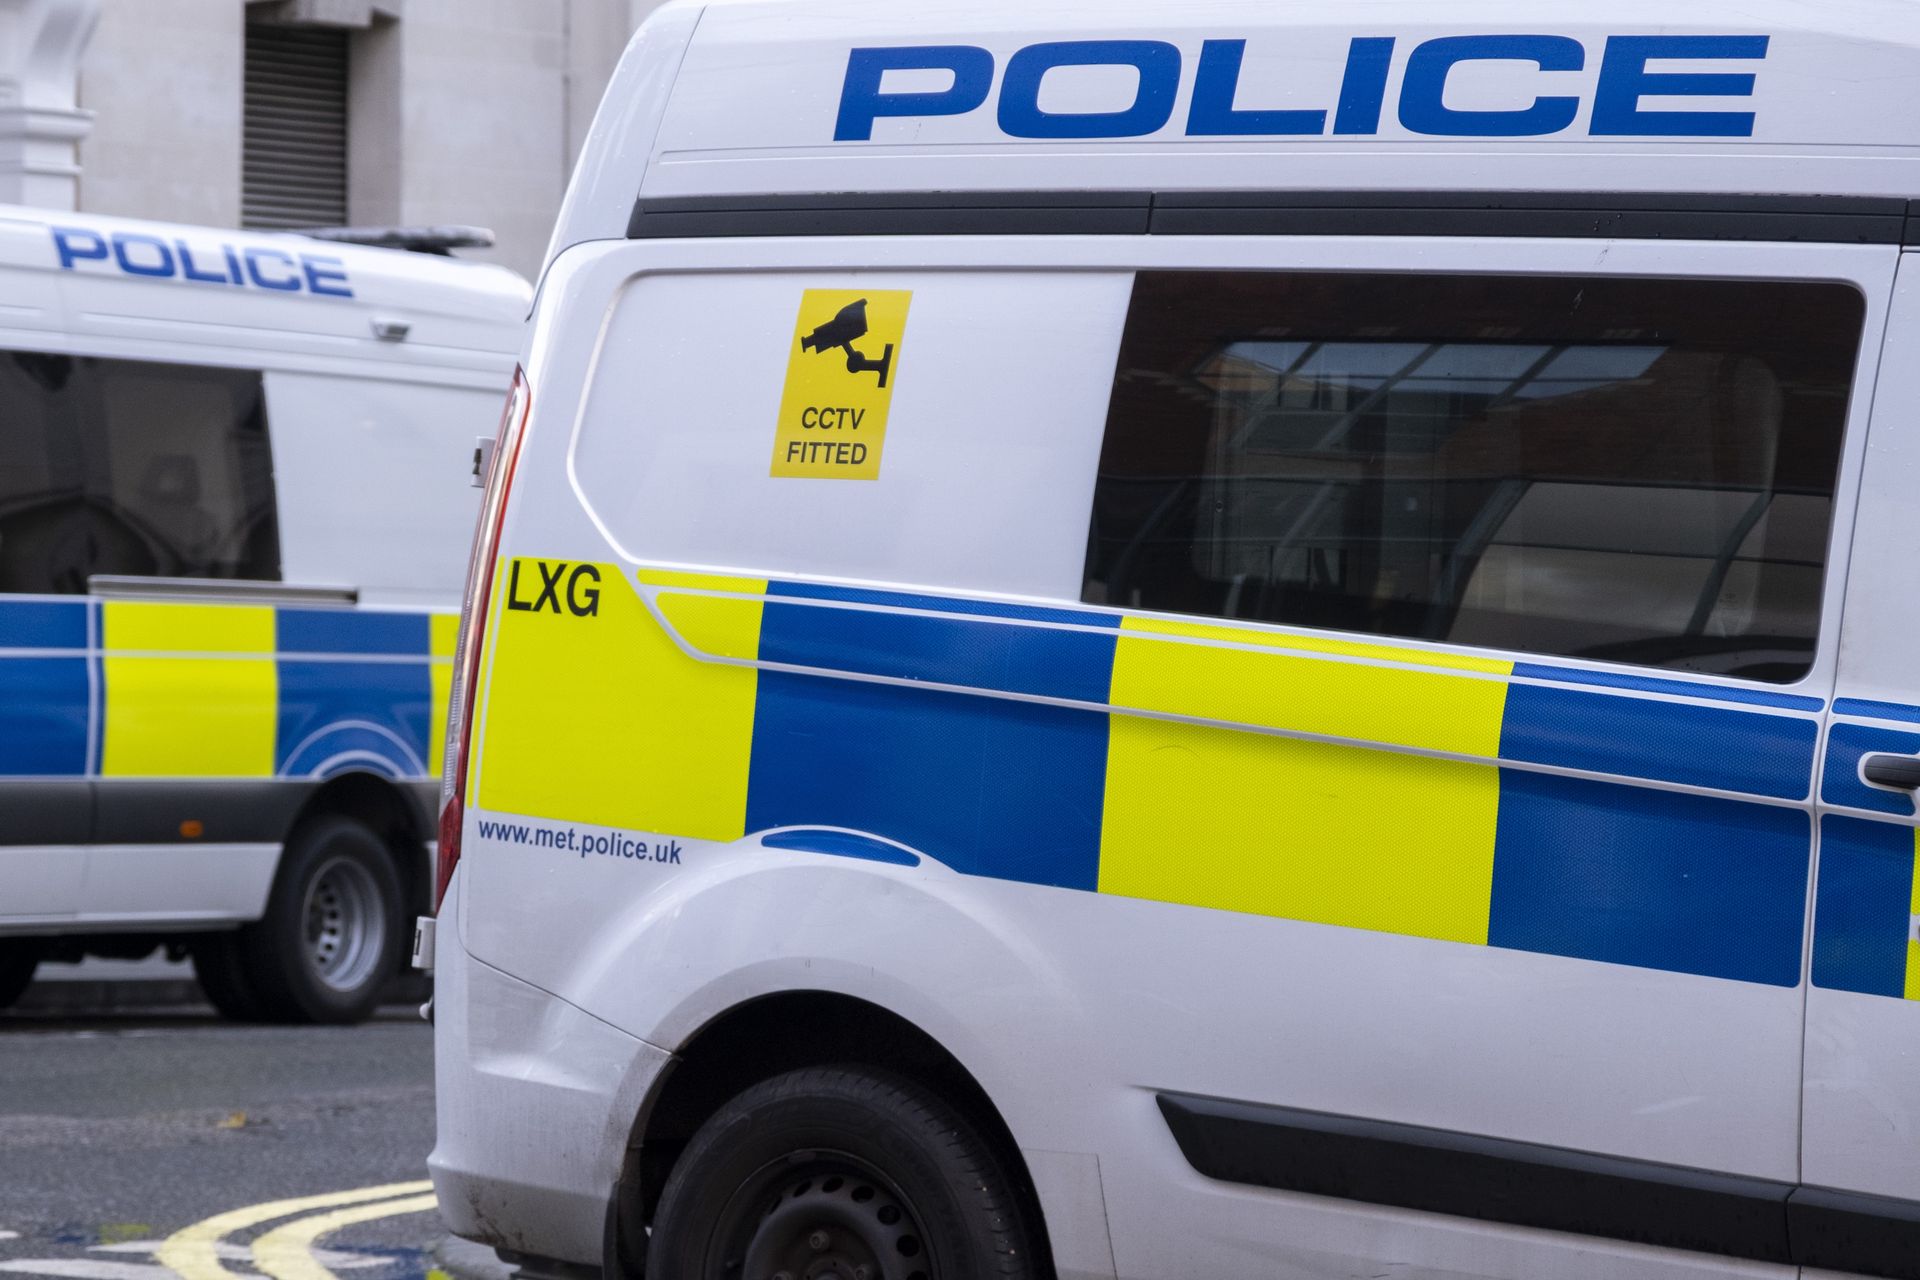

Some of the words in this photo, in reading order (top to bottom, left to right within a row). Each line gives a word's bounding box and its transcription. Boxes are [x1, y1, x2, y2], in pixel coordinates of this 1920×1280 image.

[834, 35, 1769, 141] POLICE
[53, 228, 354, 298] POLICE
[801, 406, 865, 430] CCTV
[786, 441, 868, 465] FITTED
[507, 560, 602, 617] LXG
[478, 820, 682, 865] www.met.police.uk
